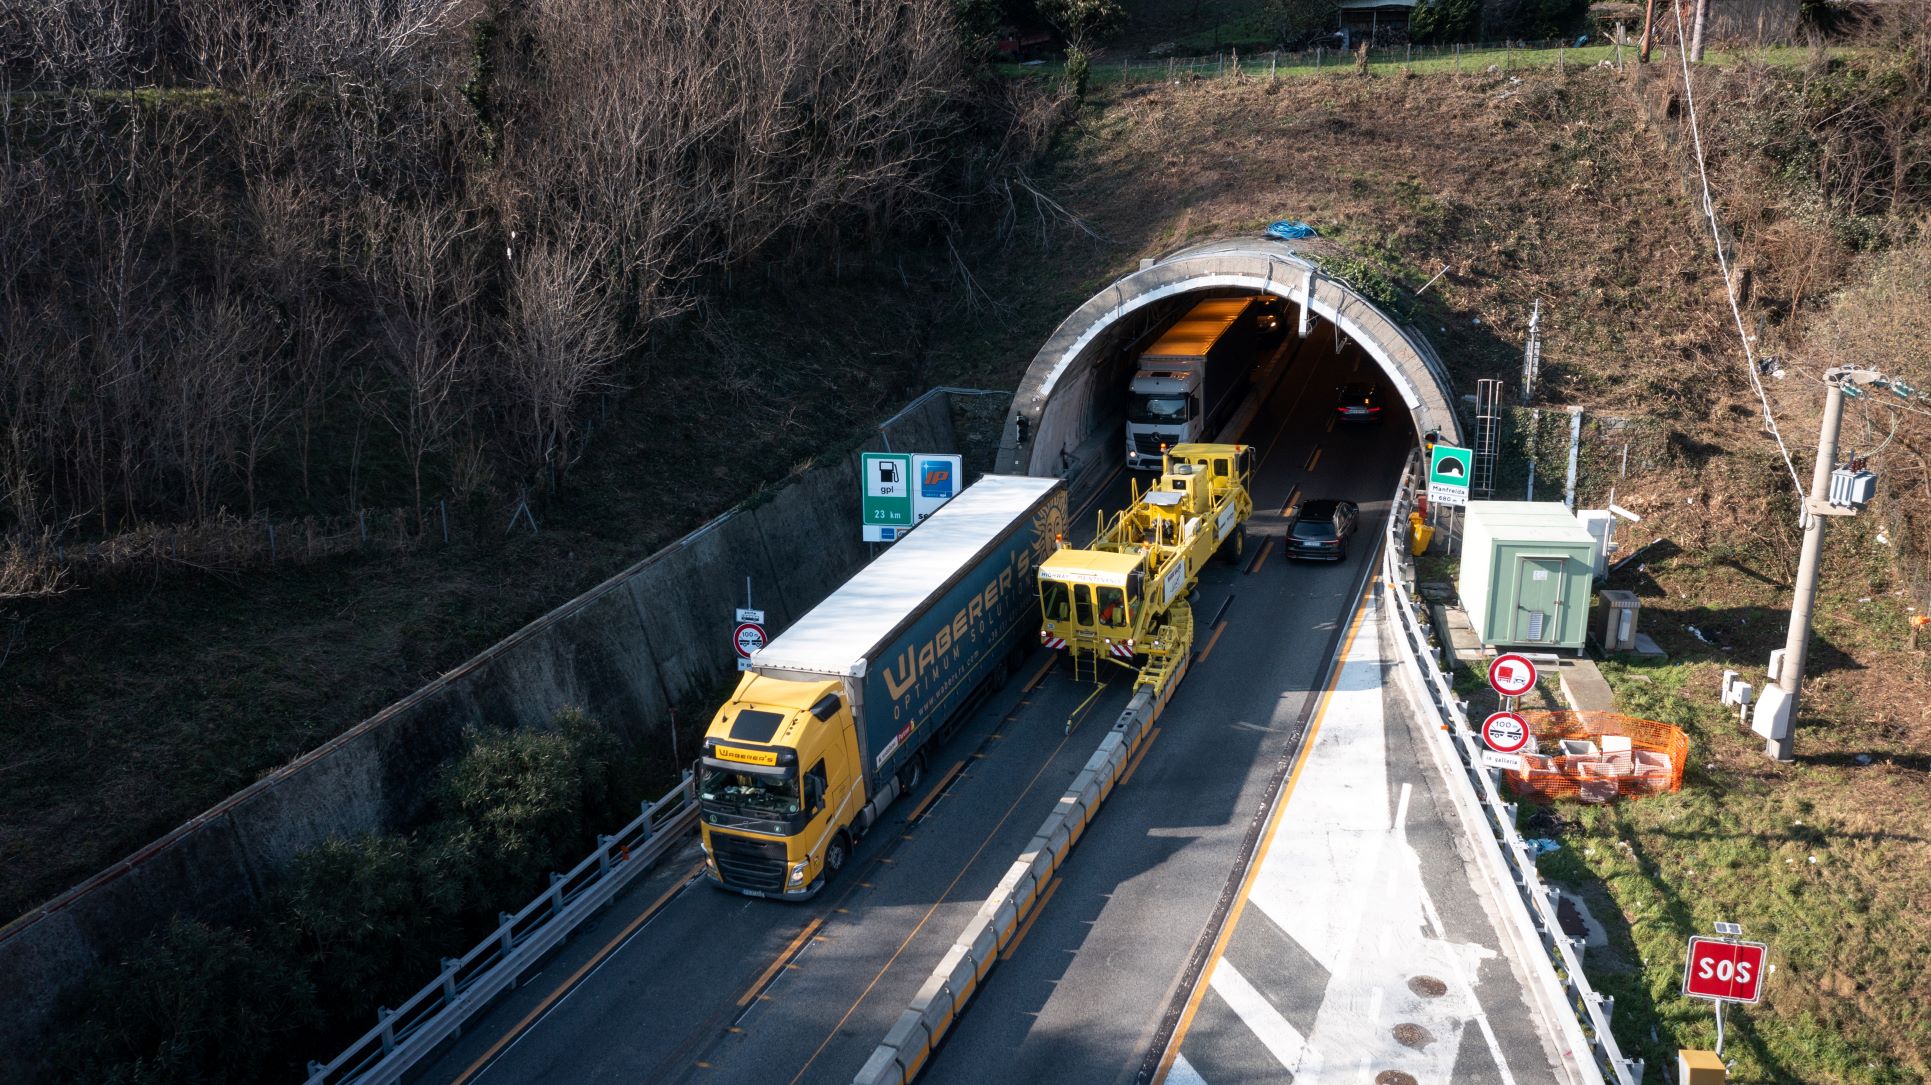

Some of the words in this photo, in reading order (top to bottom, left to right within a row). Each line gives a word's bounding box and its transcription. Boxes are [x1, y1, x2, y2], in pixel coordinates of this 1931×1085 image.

[925, 471, 949, 485] IP
[881, 486, 894, 494] gpl
[874, 510, 885, 518] 23
[890, 510, 901, 519] km
[894, 645, 961, 720] OPTIMUM
[1698, 957, 1752, 984] SOS
